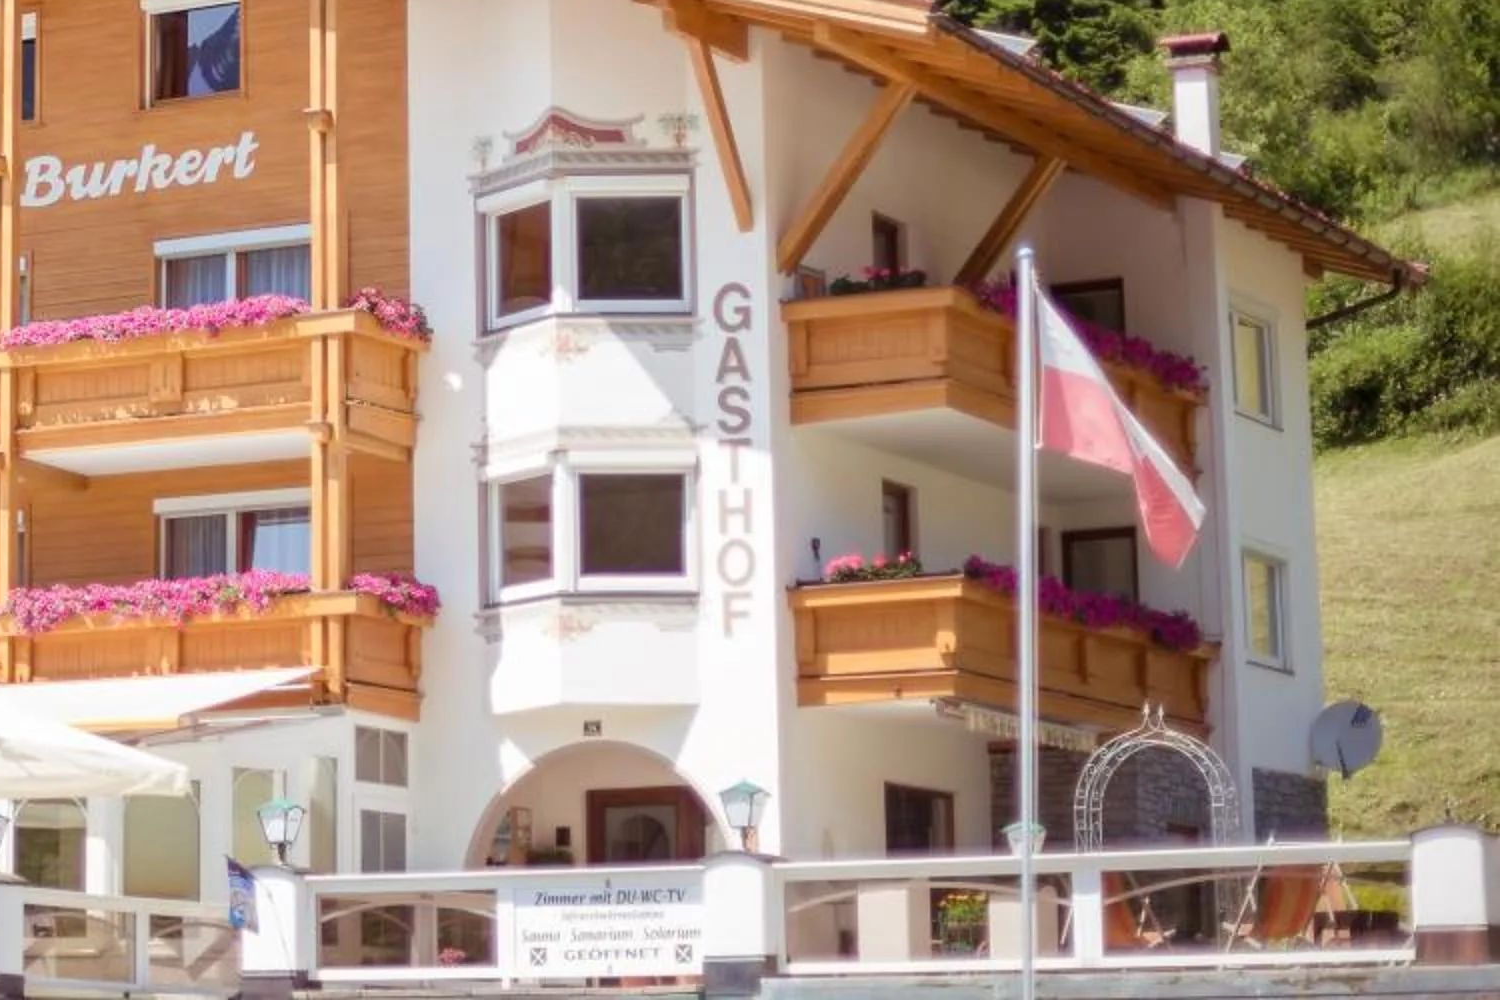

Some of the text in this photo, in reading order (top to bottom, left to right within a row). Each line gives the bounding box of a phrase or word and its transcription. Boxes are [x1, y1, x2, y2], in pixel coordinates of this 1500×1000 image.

[19, 131, 259, 207] Burkert
[712, 282, 756, 638] GASTHOF
[533, 890, 586, 906] Zimmer
[589, 889, 612, 906] mit
[522, 928, 561, 942] Sauna
[643, 925, 702, 941] Solarium
